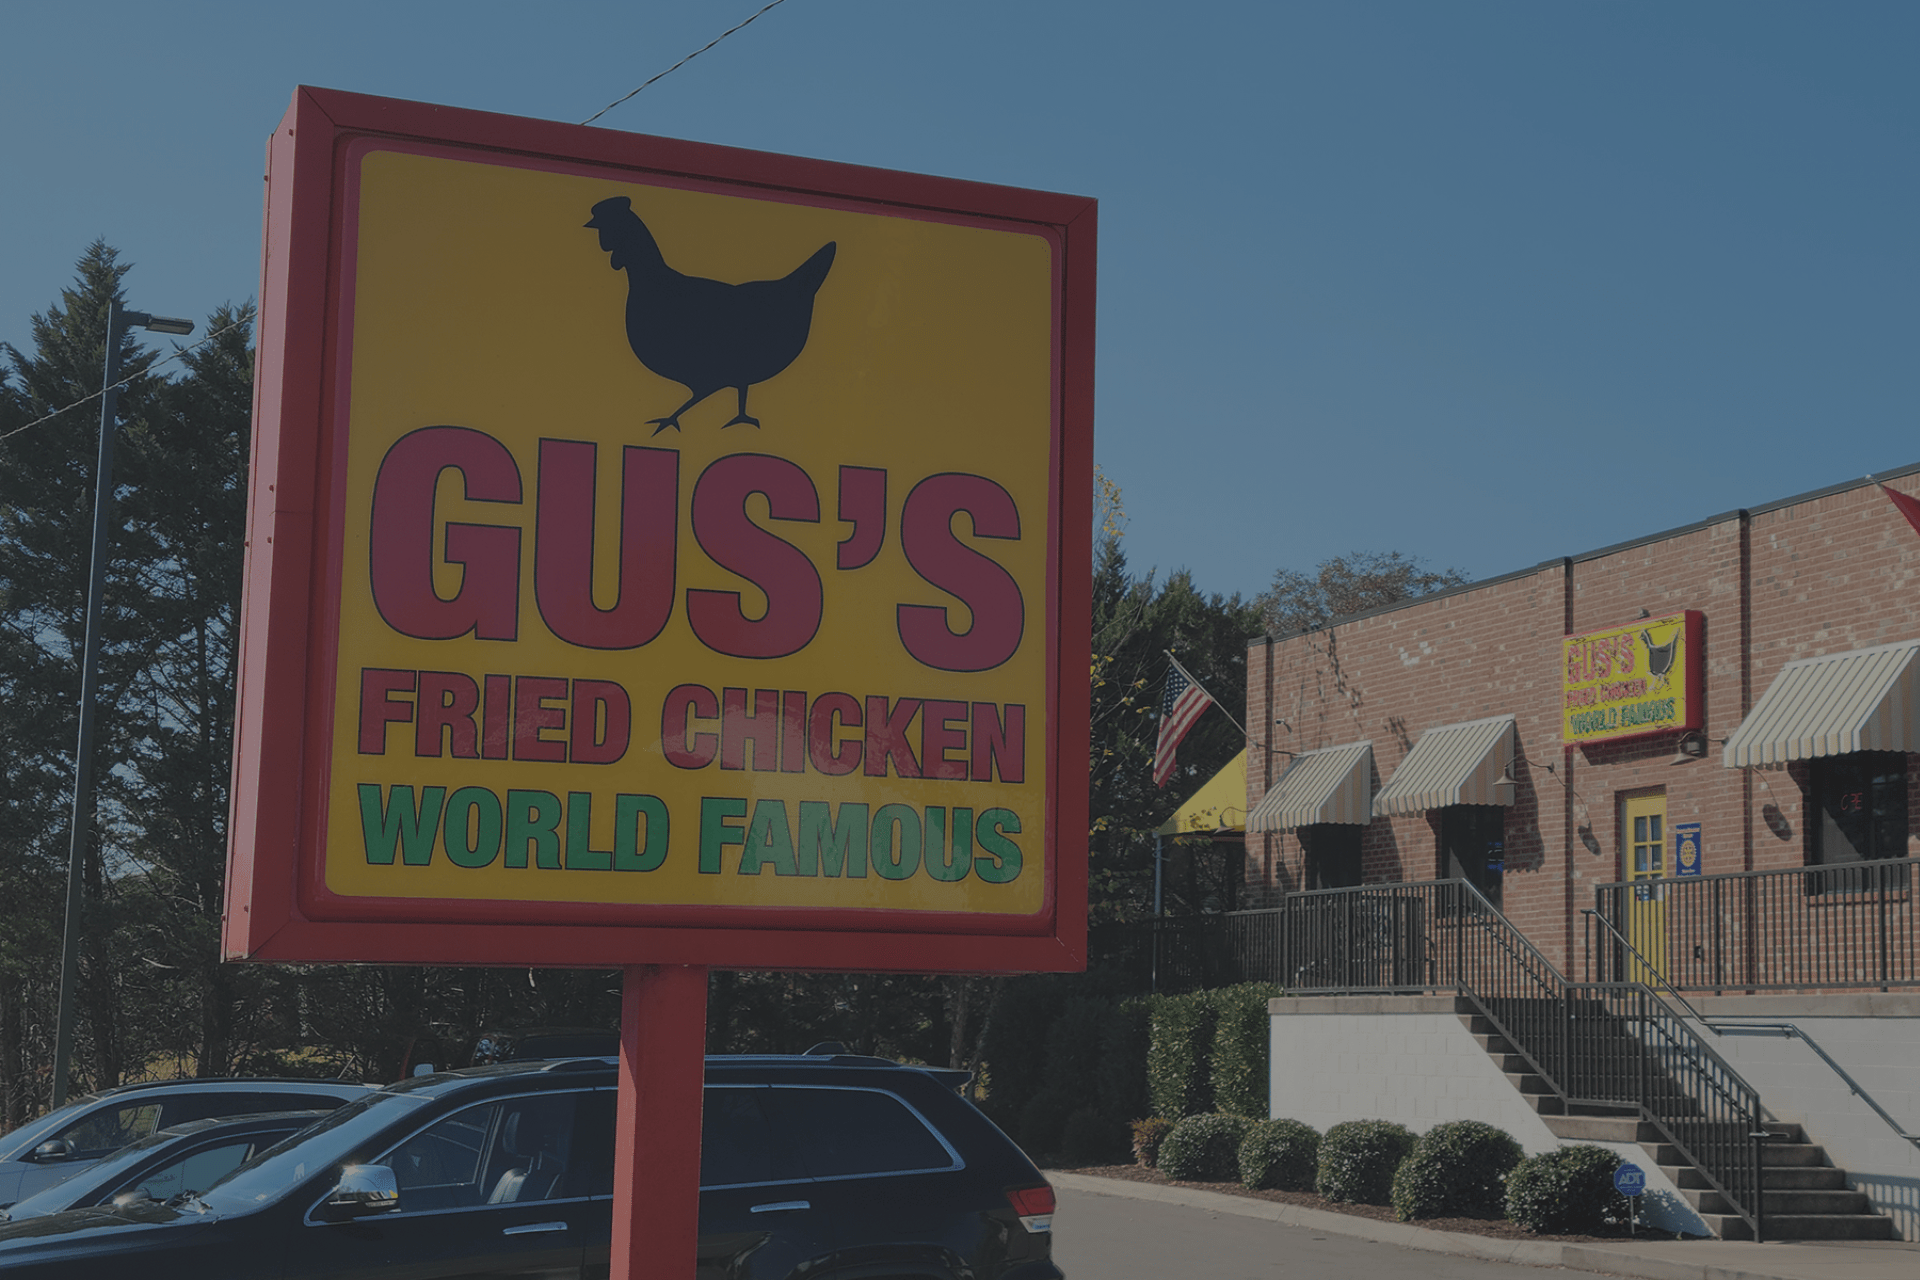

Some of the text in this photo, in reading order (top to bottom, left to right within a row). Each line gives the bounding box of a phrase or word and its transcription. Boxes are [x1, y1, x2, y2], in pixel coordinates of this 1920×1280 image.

[370, 425, 1025, 672] GUS'S
[358, 667, 1026, 783] FRIED CHICKEN
[1570, 696, 1676, 734] WORLD FAMOUS
[357, 783, 1024, 884] WORLD FAMOUS
[1618, 1172, 1642, 1185] ADT
